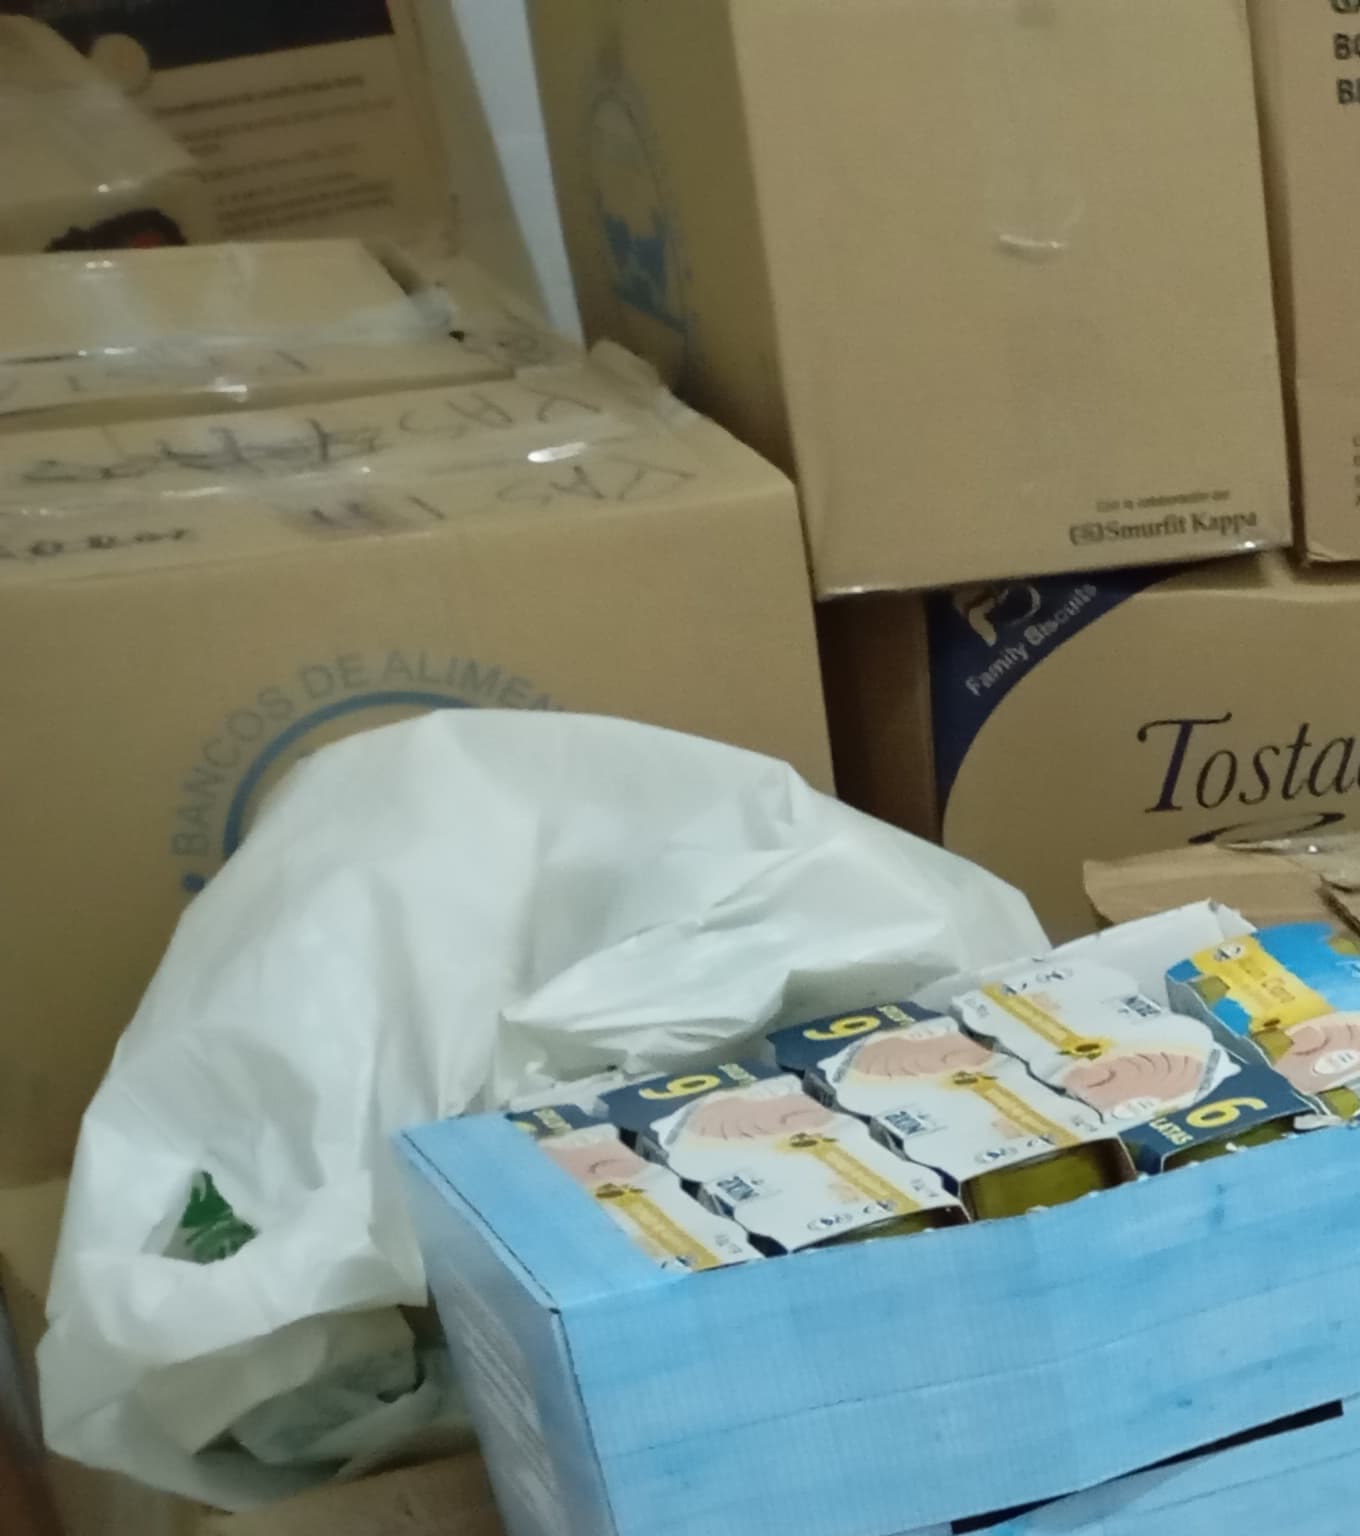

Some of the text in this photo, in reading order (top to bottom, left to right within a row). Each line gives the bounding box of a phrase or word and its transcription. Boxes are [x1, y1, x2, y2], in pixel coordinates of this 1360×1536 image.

[1103, 511, 1257, 542] Smurfit Kappa
[964, 583, 1098, 697] Family Biscuits
[170, 684, 295, 858] BANCOS
[297, 651, 369, 700] DE
[1186, 1096, 1269, 1130] 6
